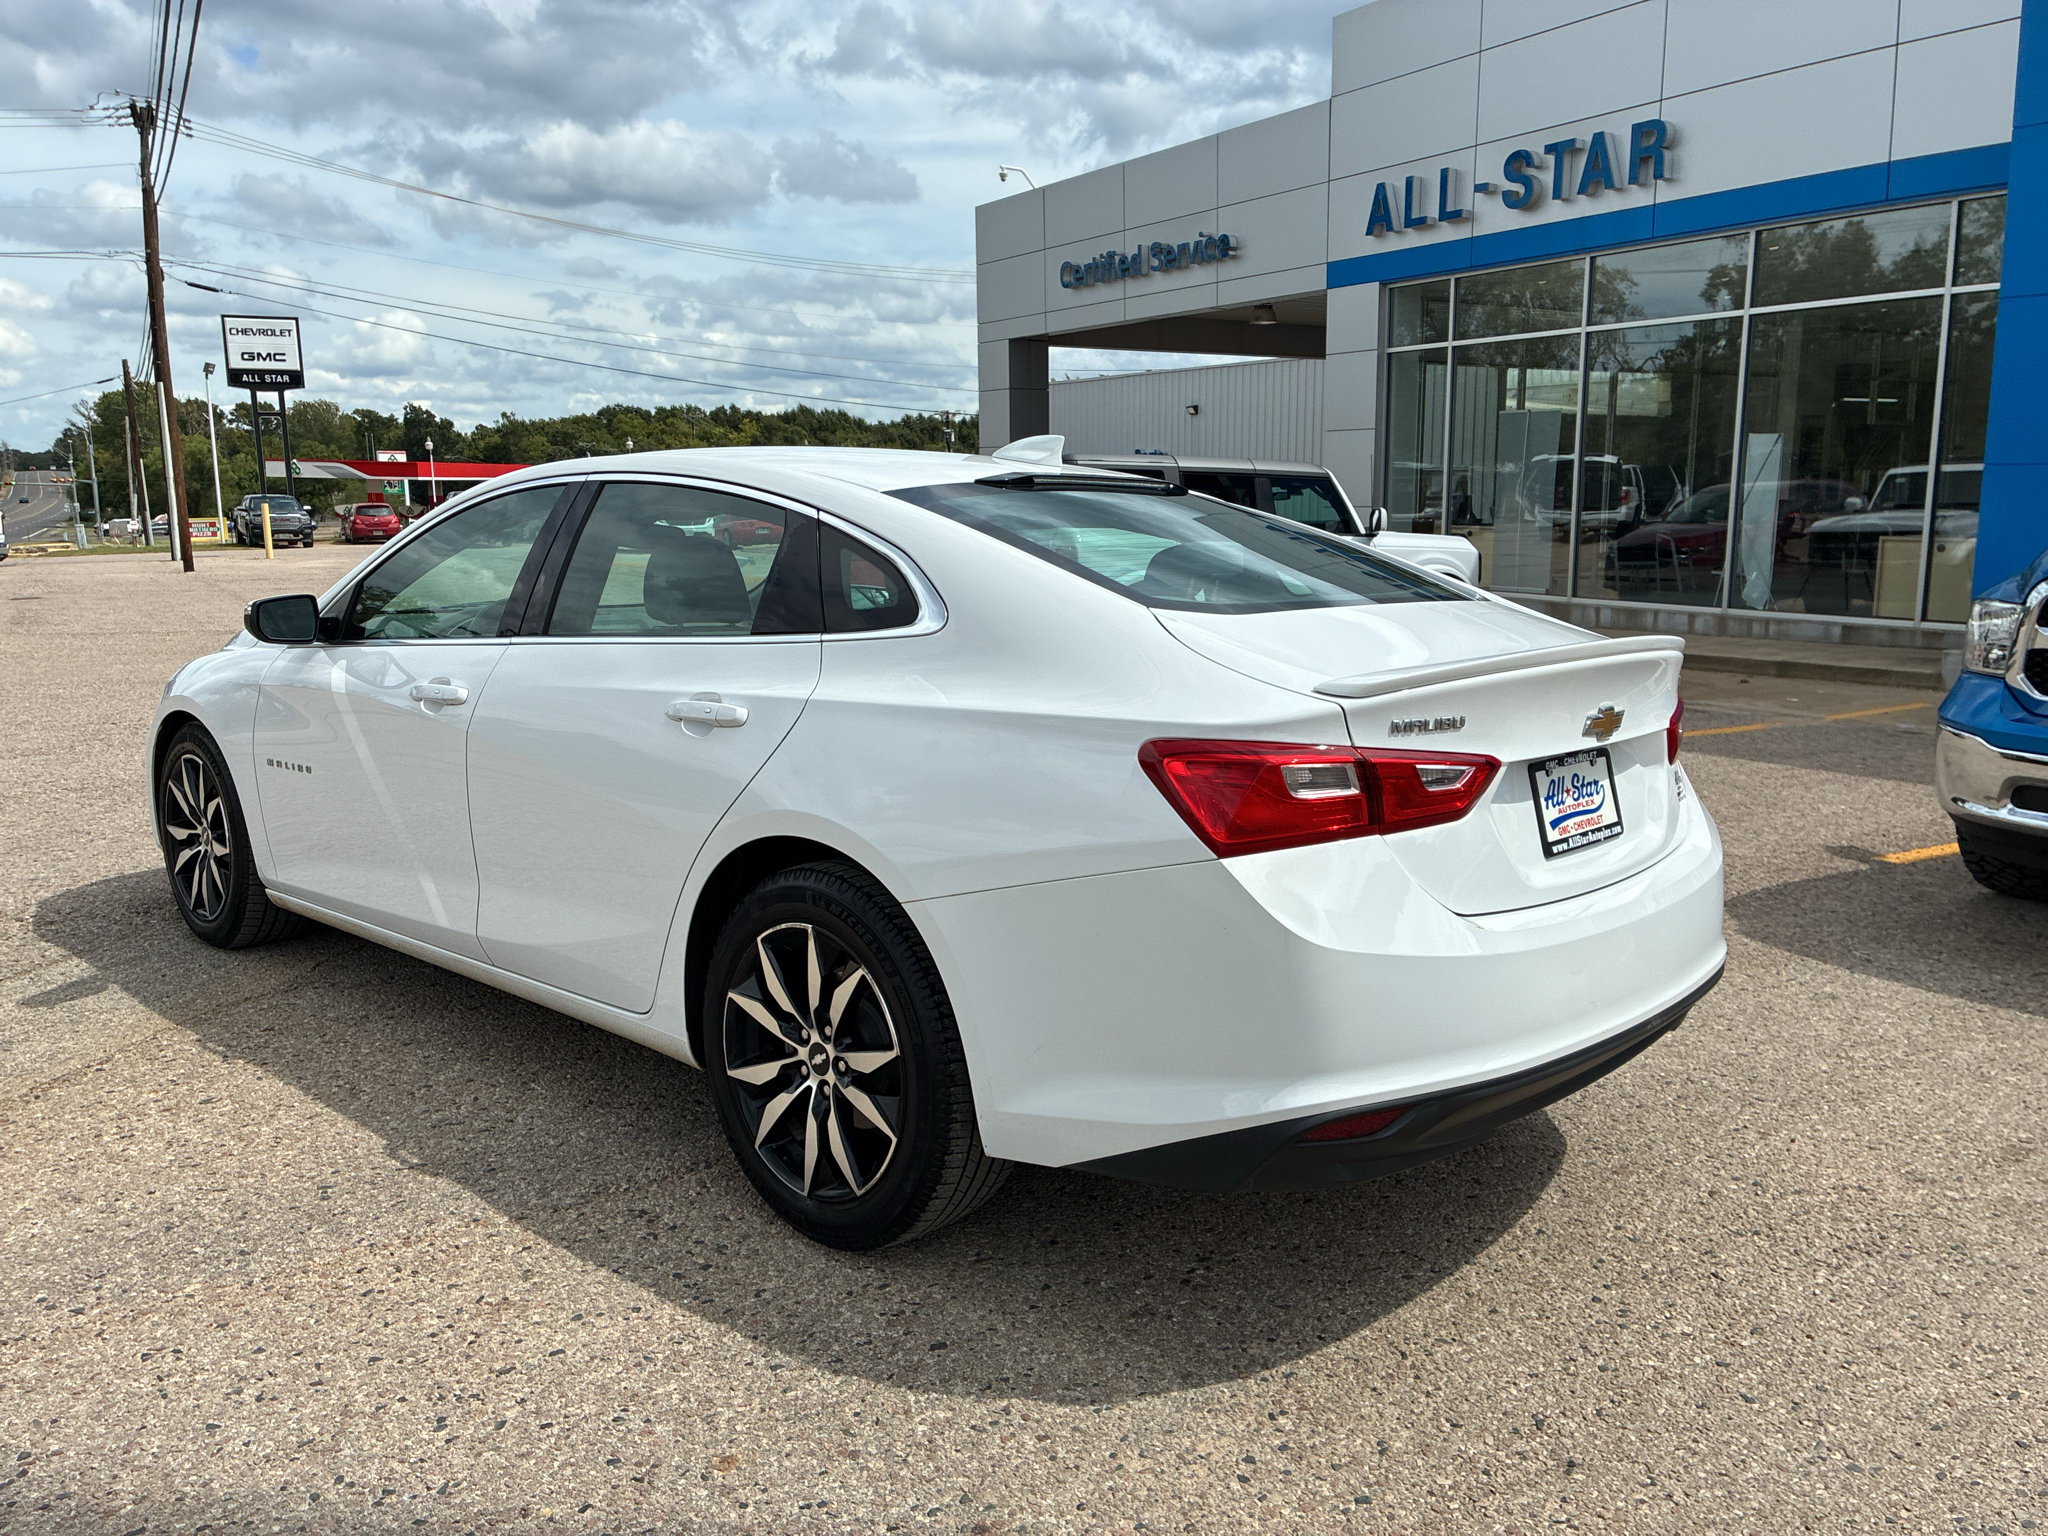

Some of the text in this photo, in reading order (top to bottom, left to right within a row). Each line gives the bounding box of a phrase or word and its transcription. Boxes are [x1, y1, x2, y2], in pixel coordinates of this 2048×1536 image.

[1365, 118, 1676, 237] ALL-STAR
[1060, 231, 1237, 289] Certified Service
[229, 327, 293, 338] CHEVROLET
[240, 351, 287, 362] GMC
[242, 374, 290, 383] ALL STAR
[1389, 715, 1466, 735] MALIBU
[266, 758, 312, 774] MALIBU
[1545, 751, 1598, 770] GMC CHEVROLET
[1544, 772, 1601, 810] All Star
[1557, 798, 1596, 815] AUTOPLEX
[1557, 814, 1604, 836] GMC CHEVROLET
[1552, 825, 1622, 854] www.AllStarAutoplex.com
